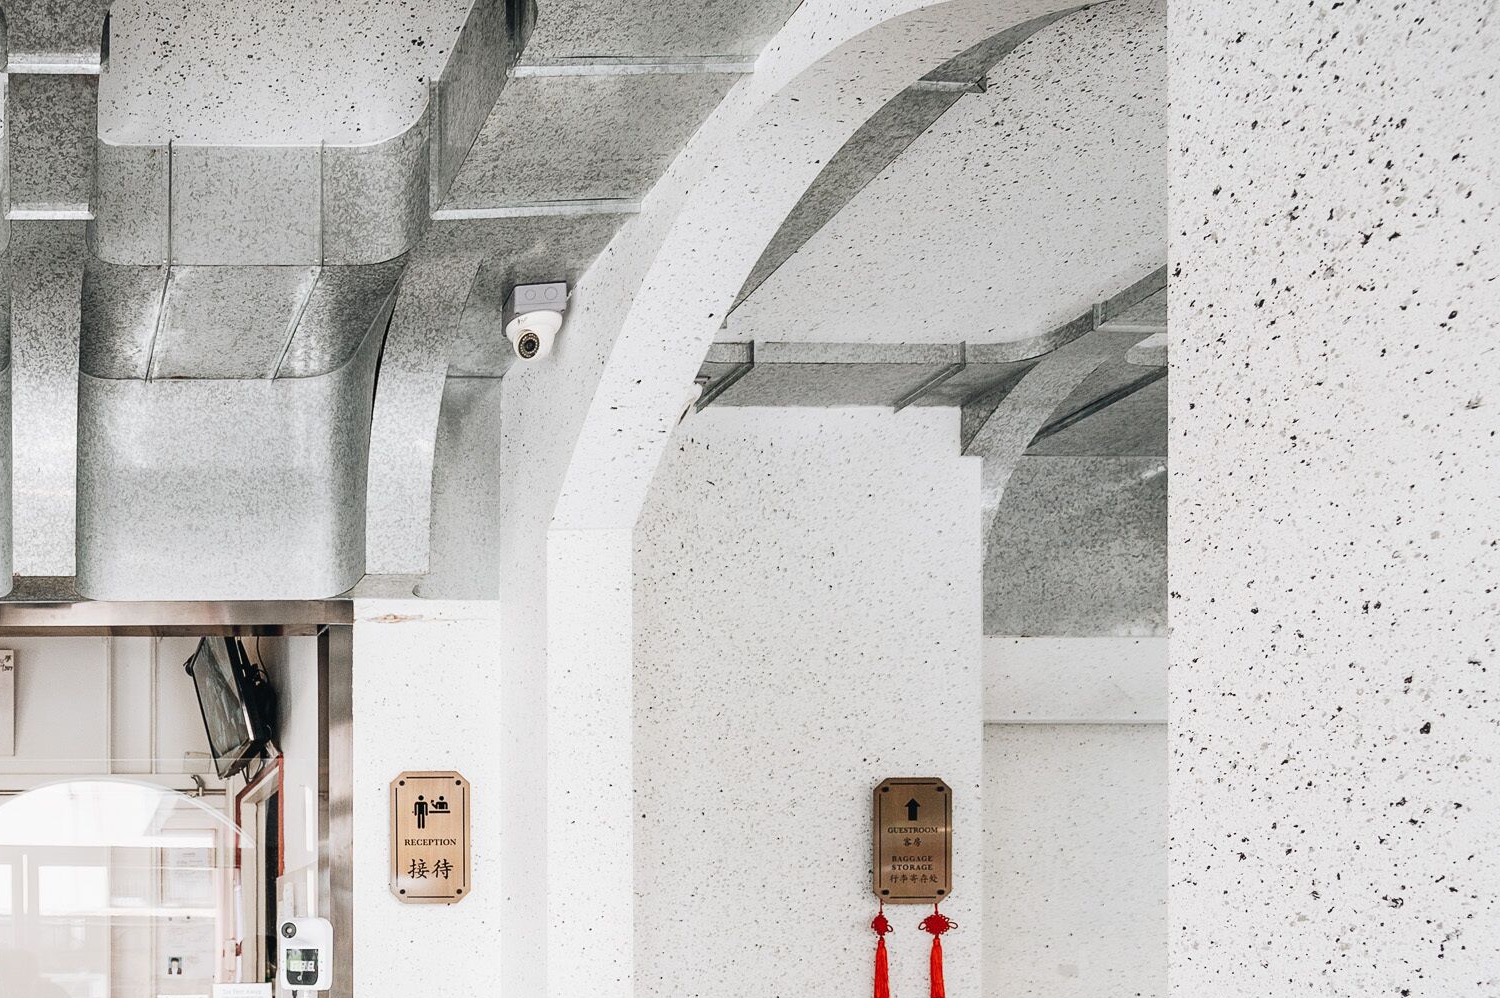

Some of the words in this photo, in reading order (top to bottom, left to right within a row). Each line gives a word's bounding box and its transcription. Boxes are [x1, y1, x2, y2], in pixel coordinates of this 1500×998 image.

[887, 826, 938, 834] GUESTROOM
[404, 838, 457, 846] RECEPTION
[407, 858, 454, 880] 接待
